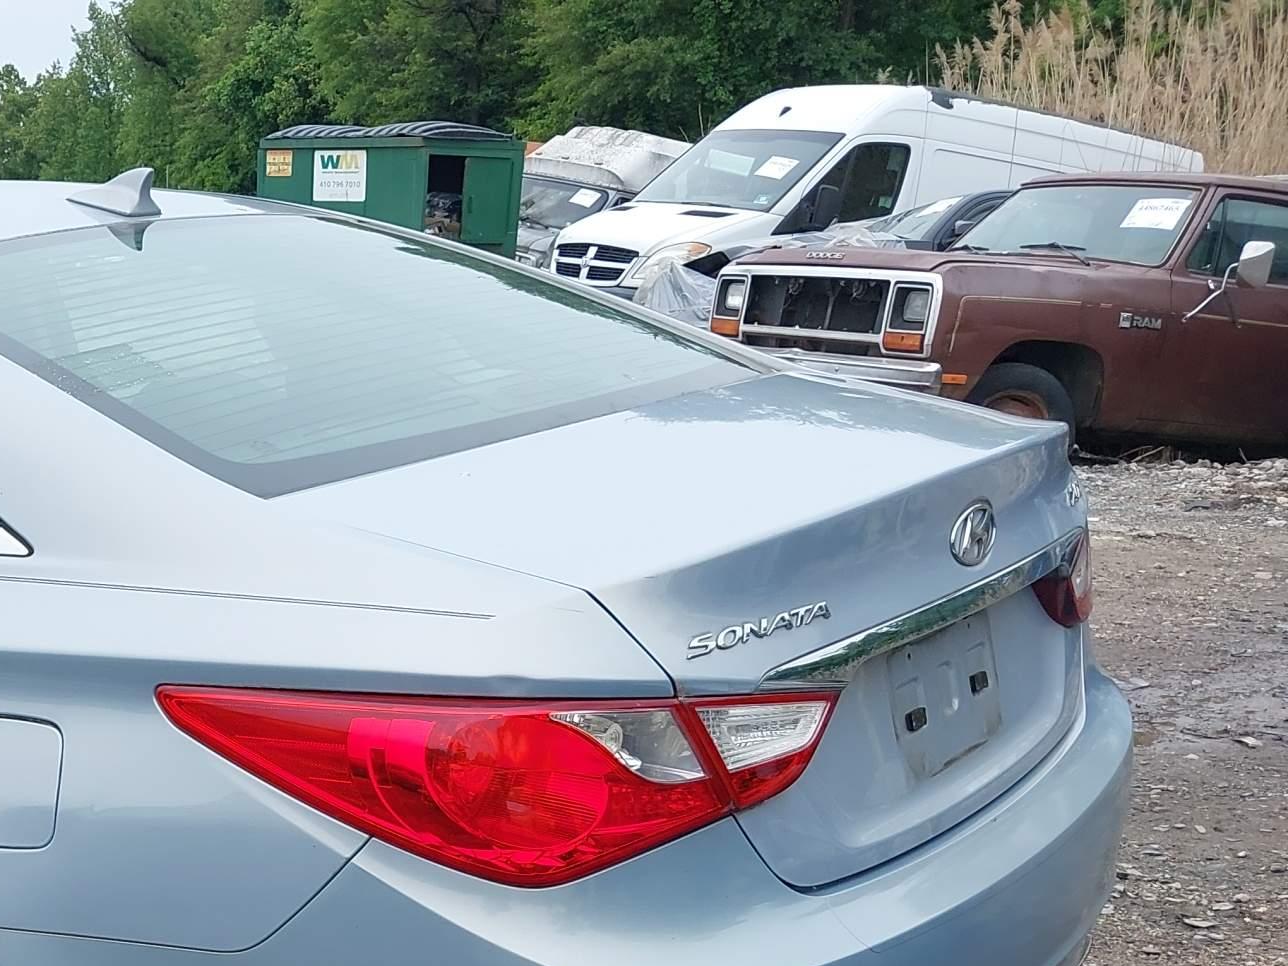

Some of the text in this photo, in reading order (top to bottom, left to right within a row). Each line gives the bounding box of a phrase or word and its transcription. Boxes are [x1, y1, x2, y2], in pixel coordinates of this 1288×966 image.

[806, 252, 846, 260] DODGE
[1132, 316, 1162, 329] RAM
[686, 601, 832, 660] SONATA
